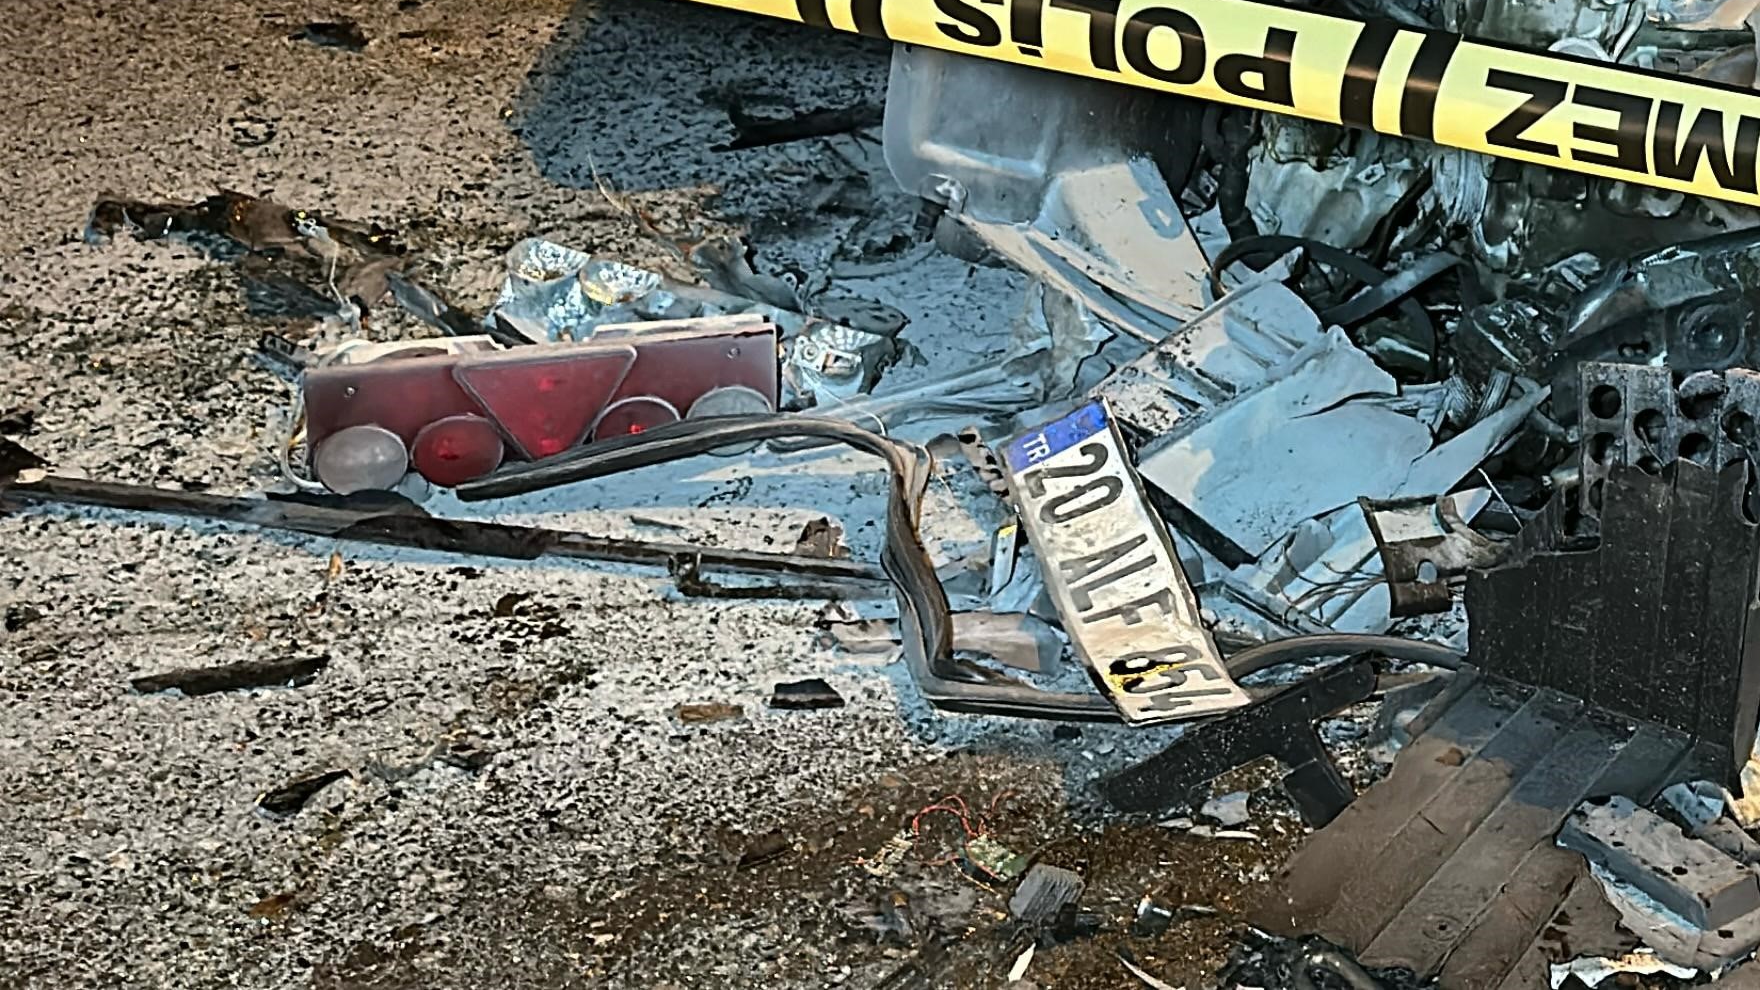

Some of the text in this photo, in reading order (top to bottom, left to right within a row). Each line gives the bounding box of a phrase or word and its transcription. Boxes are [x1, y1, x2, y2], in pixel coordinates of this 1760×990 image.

[1022, 432, 1052, 463] TR
[1023, 442, 1124, 524] 20
[1058, 532, 1177, 626] ALF
